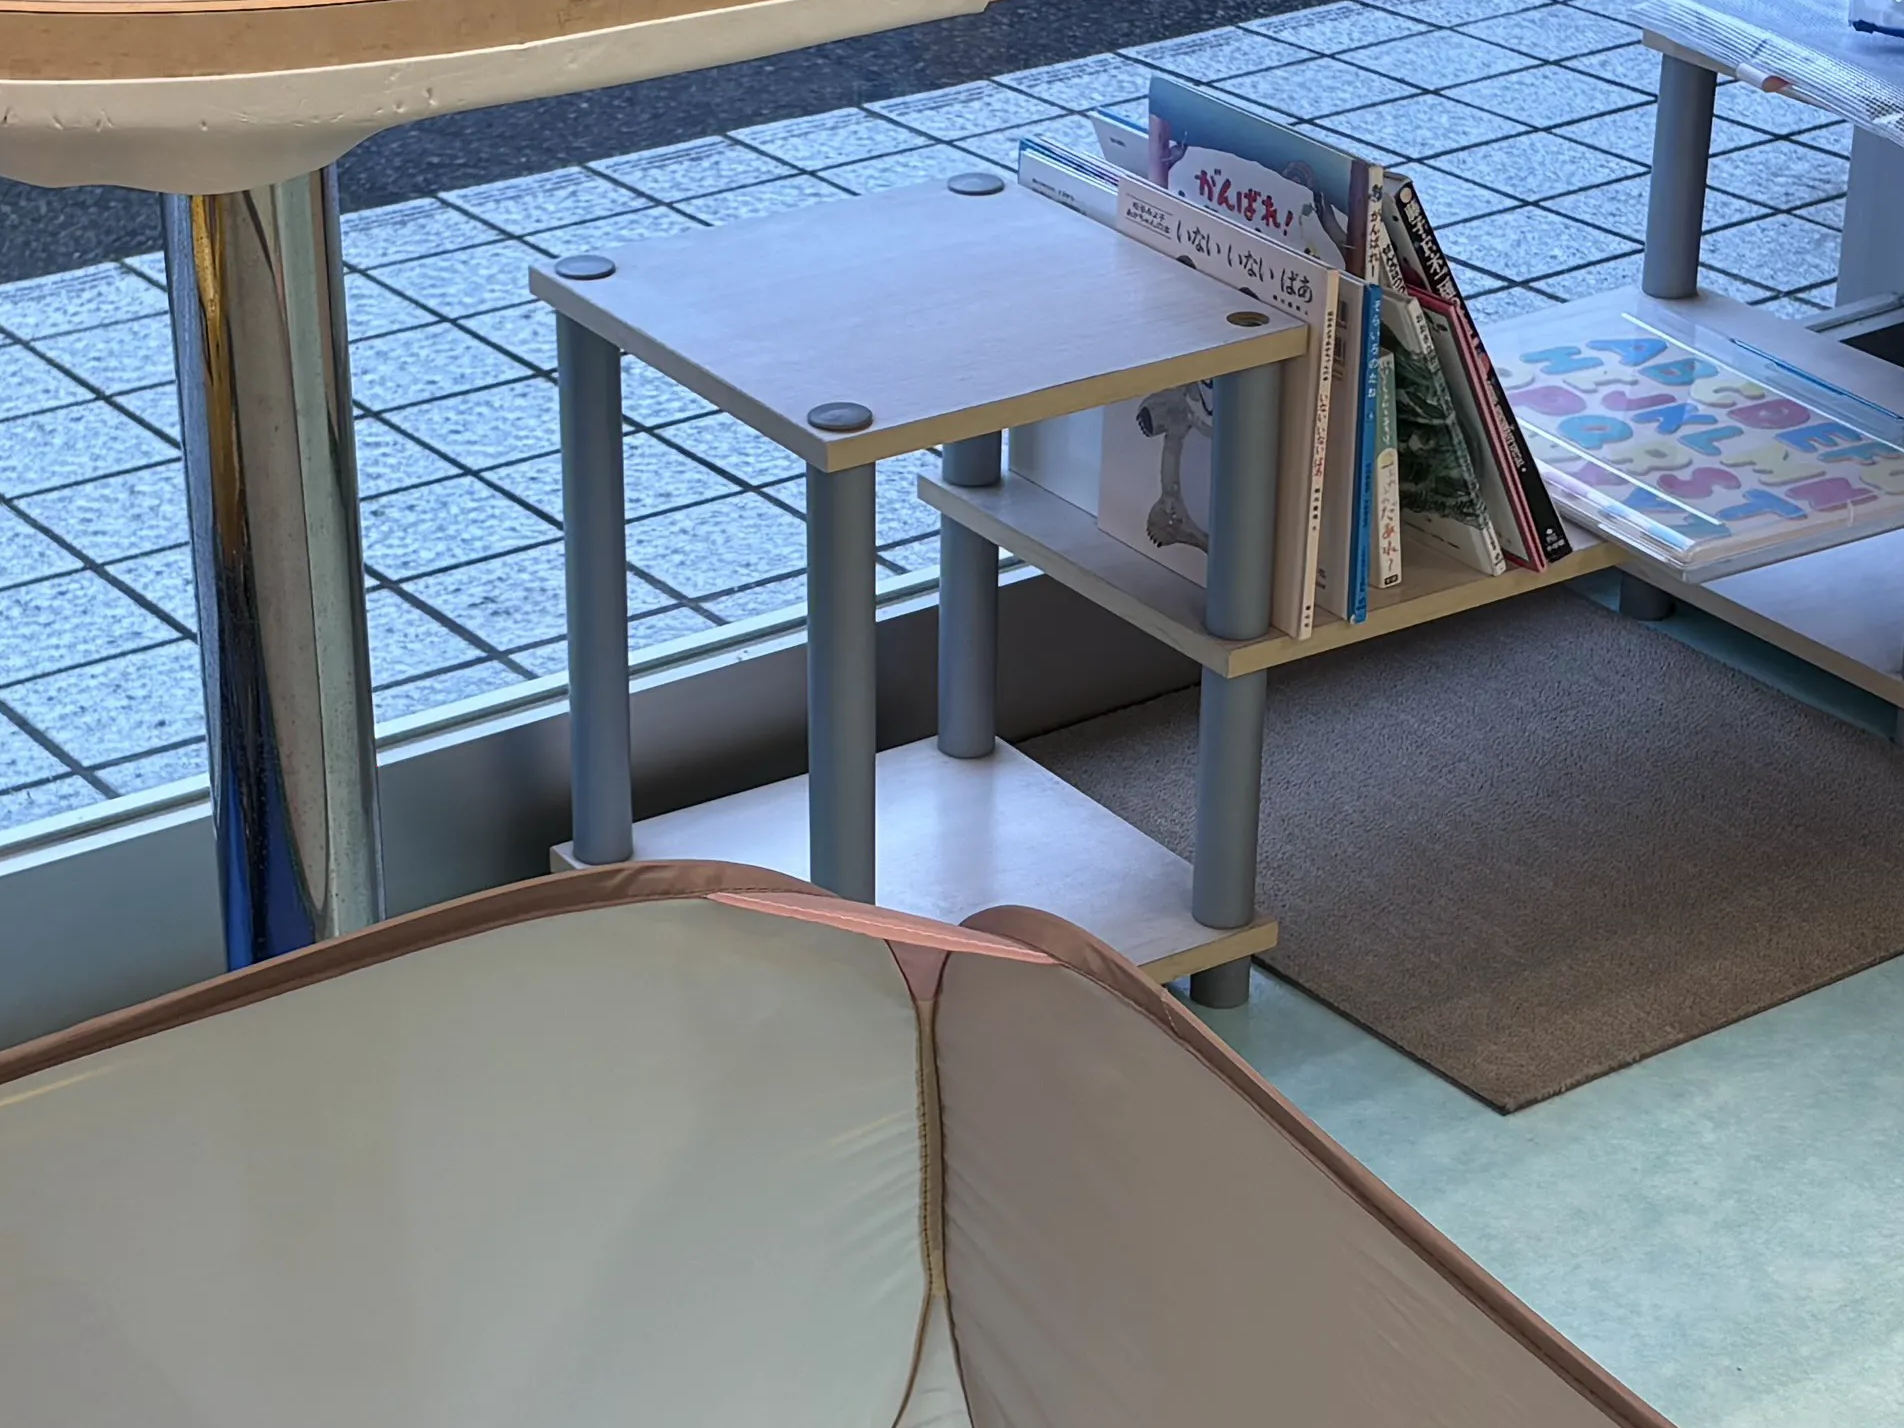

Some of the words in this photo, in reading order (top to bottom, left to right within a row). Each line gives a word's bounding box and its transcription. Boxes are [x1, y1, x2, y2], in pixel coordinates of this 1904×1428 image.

[1194, 168, 1295, 237] がんばれ!
[1176, 219, 1222, 258] いない
[1226, 243, 1276, 283] いない
[1280, 267, 1314, 305] ばあ
